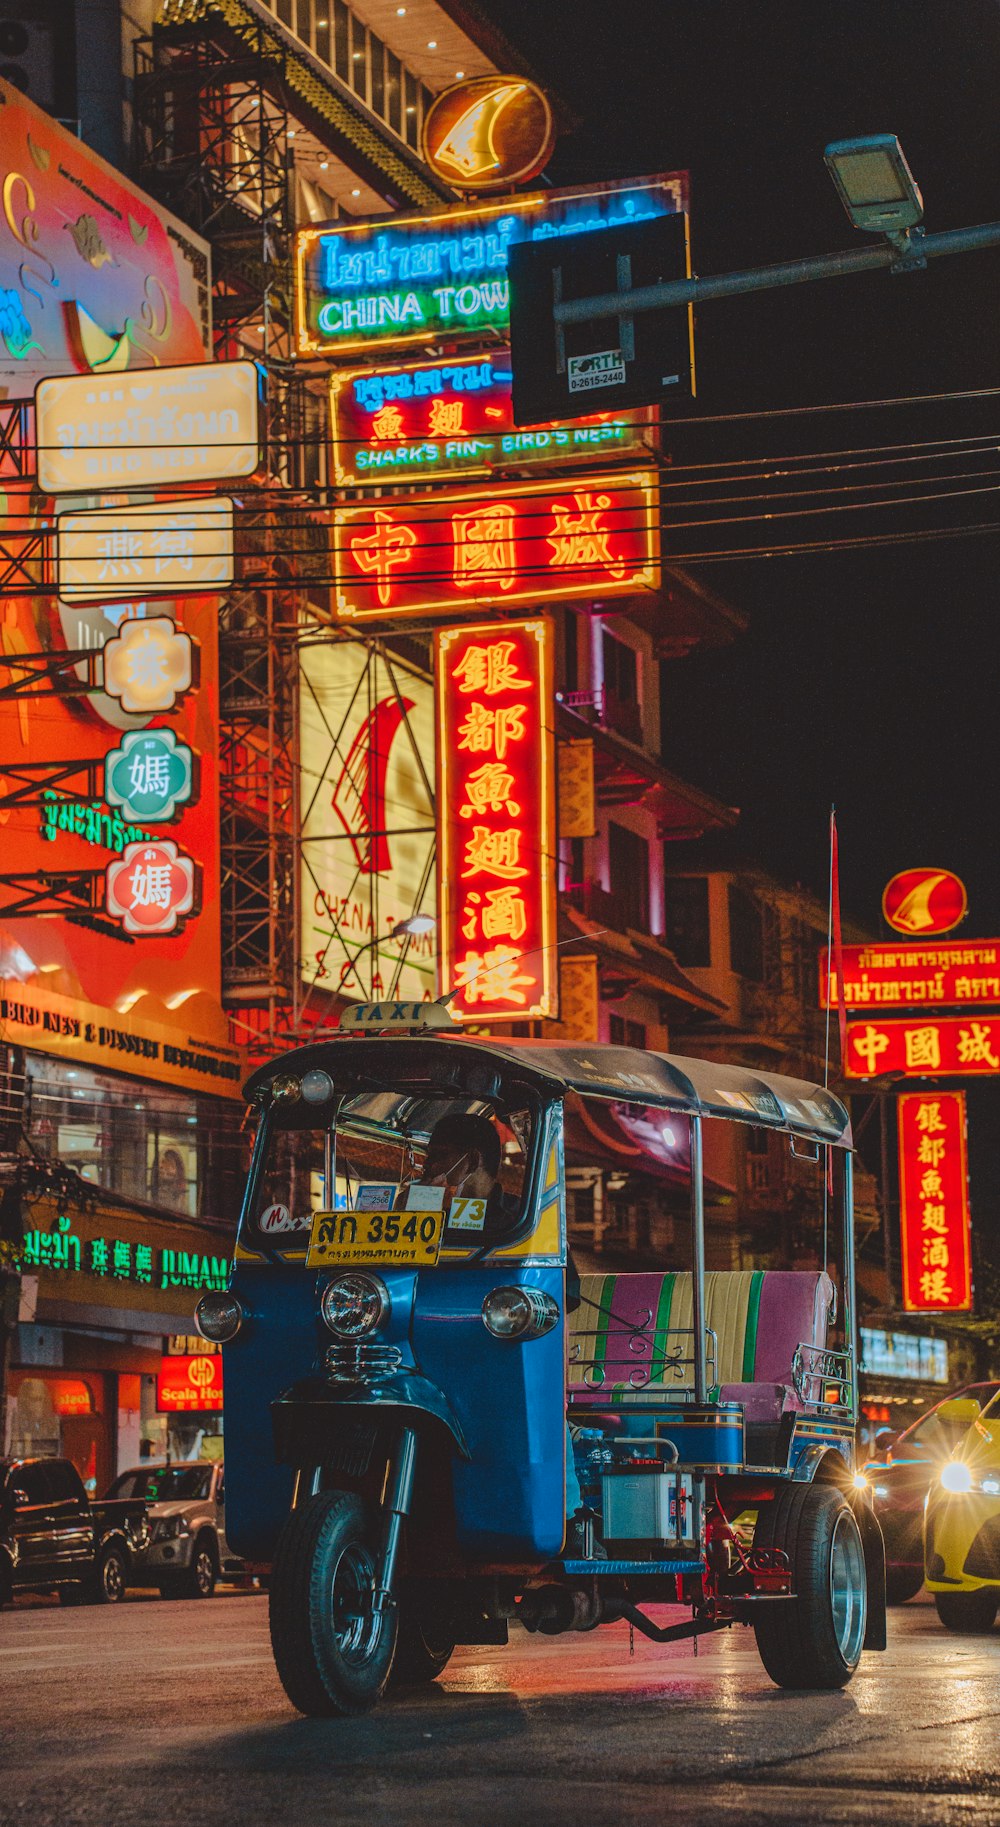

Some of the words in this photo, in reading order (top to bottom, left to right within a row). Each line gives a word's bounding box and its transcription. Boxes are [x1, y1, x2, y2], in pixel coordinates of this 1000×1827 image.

[318, 292, 424, 332] CHINA
[571, 372, 624, 389] 0-2615-2440
[151, 447, 208, 468] NEST
[355, 442, 438, 469] SHARK'S
[501, 427, 569, 453] BIRD'S
[573, 420, 628, 443] NEST
[351, 488, 626, 607] 中國城
[128, 753, 171, 799] 媽
[129, 864, 172, 910] 媽
[314, 889, 376, 936] CHINA
[1, 1000, 40, 1026] BIRD
[43, 1011, 81, 1037] NEST
[354, 1003, 422, 1021] TAXI
[853, 1023, 1000, 1073] 中國城
[318, 1215, 357, 1243] สก
[367, 1215, 436, 1243] 3540
[453, 1199, 485, 1221] 73
[161, 1387, 198, 1401] Scala
